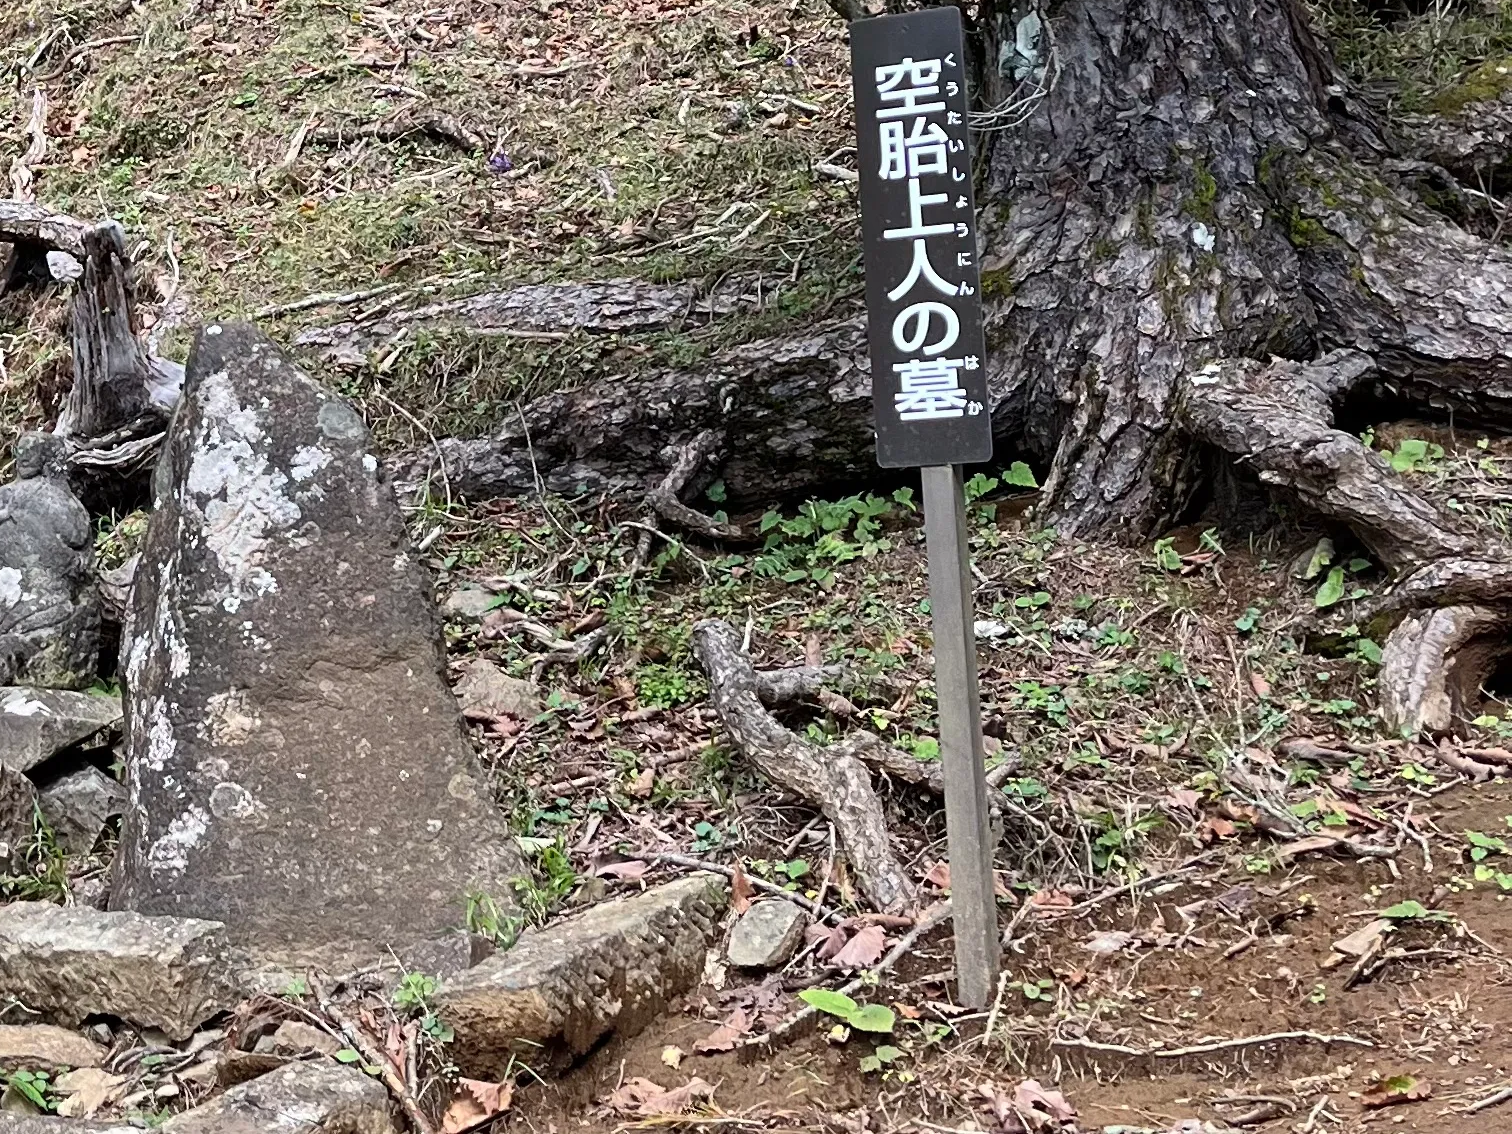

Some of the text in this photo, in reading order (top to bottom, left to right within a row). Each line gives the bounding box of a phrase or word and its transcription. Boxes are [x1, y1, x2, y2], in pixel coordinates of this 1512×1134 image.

[874, 56, 968, 421] 空胎上人の墓
[944, 52, 975, 297] くうたいしょうにん
[964, 354, 984, 417] はか
